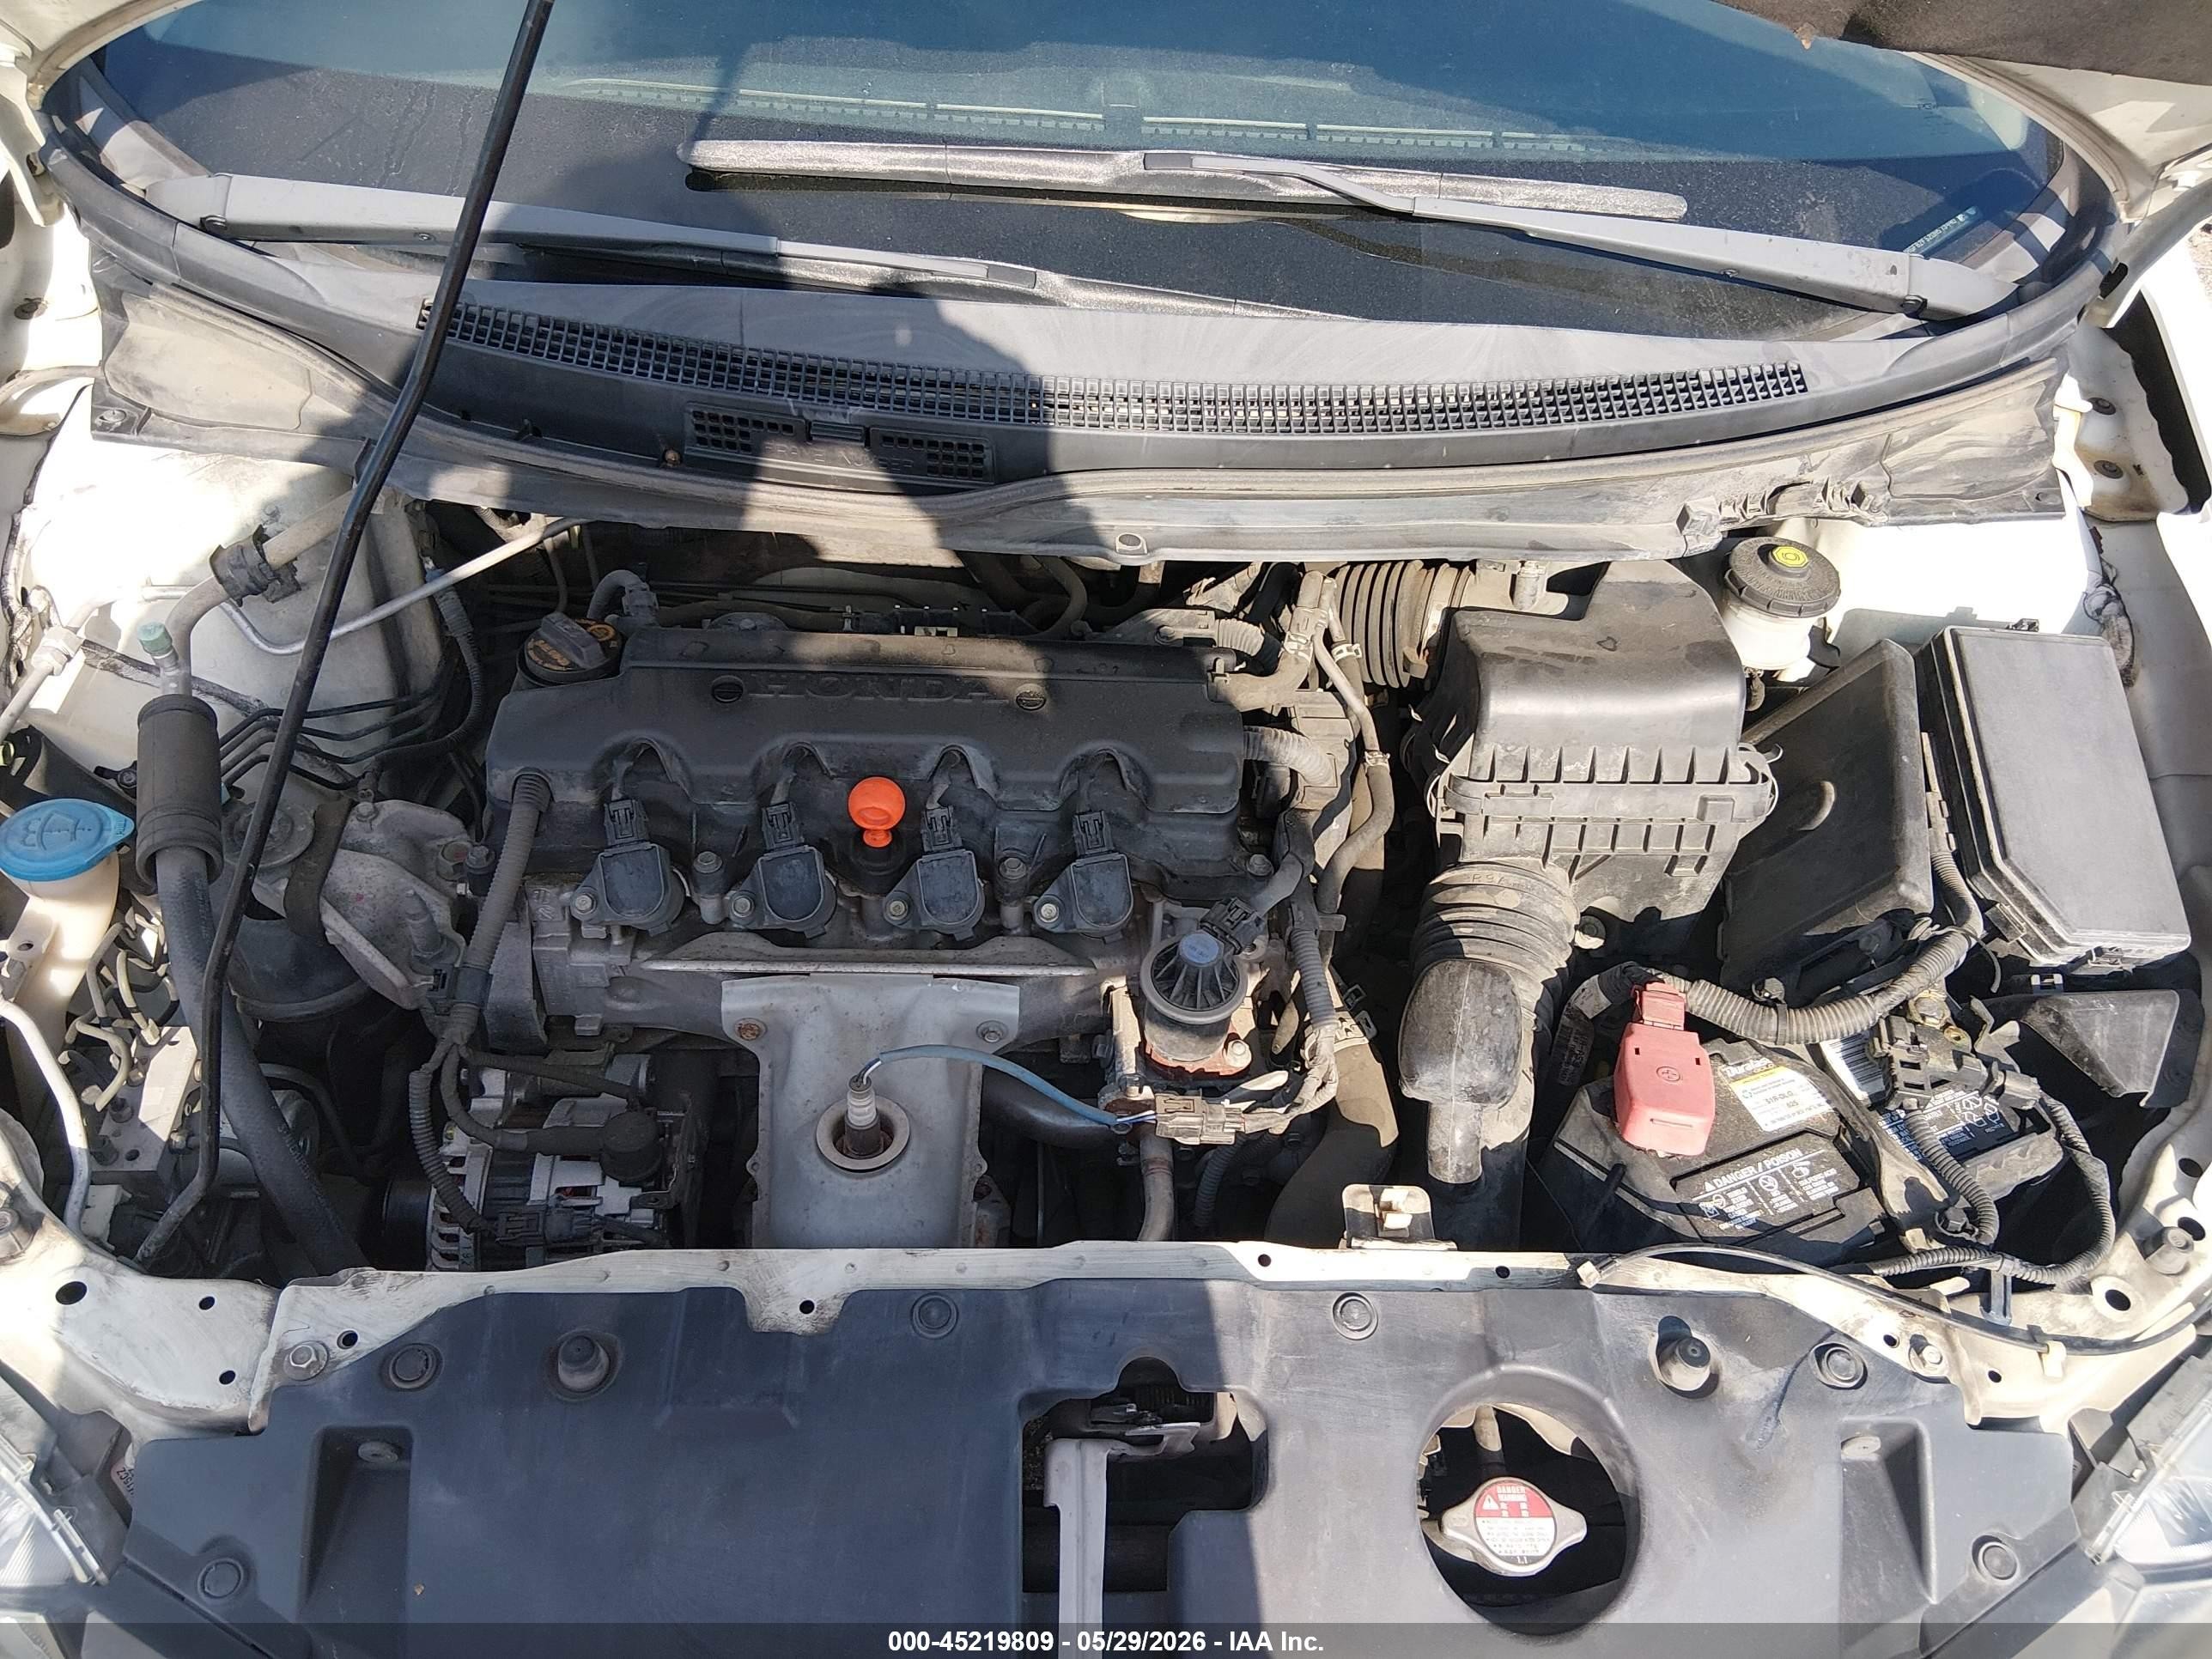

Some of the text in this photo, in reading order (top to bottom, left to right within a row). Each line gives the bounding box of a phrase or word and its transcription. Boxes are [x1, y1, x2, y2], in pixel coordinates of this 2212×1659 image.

[748, 673, 1010, 704] HONDA
[1715, 1147, 1803, 1189] DANGER / POISON
[1497, 1486, 1526, 1494] DANGER
